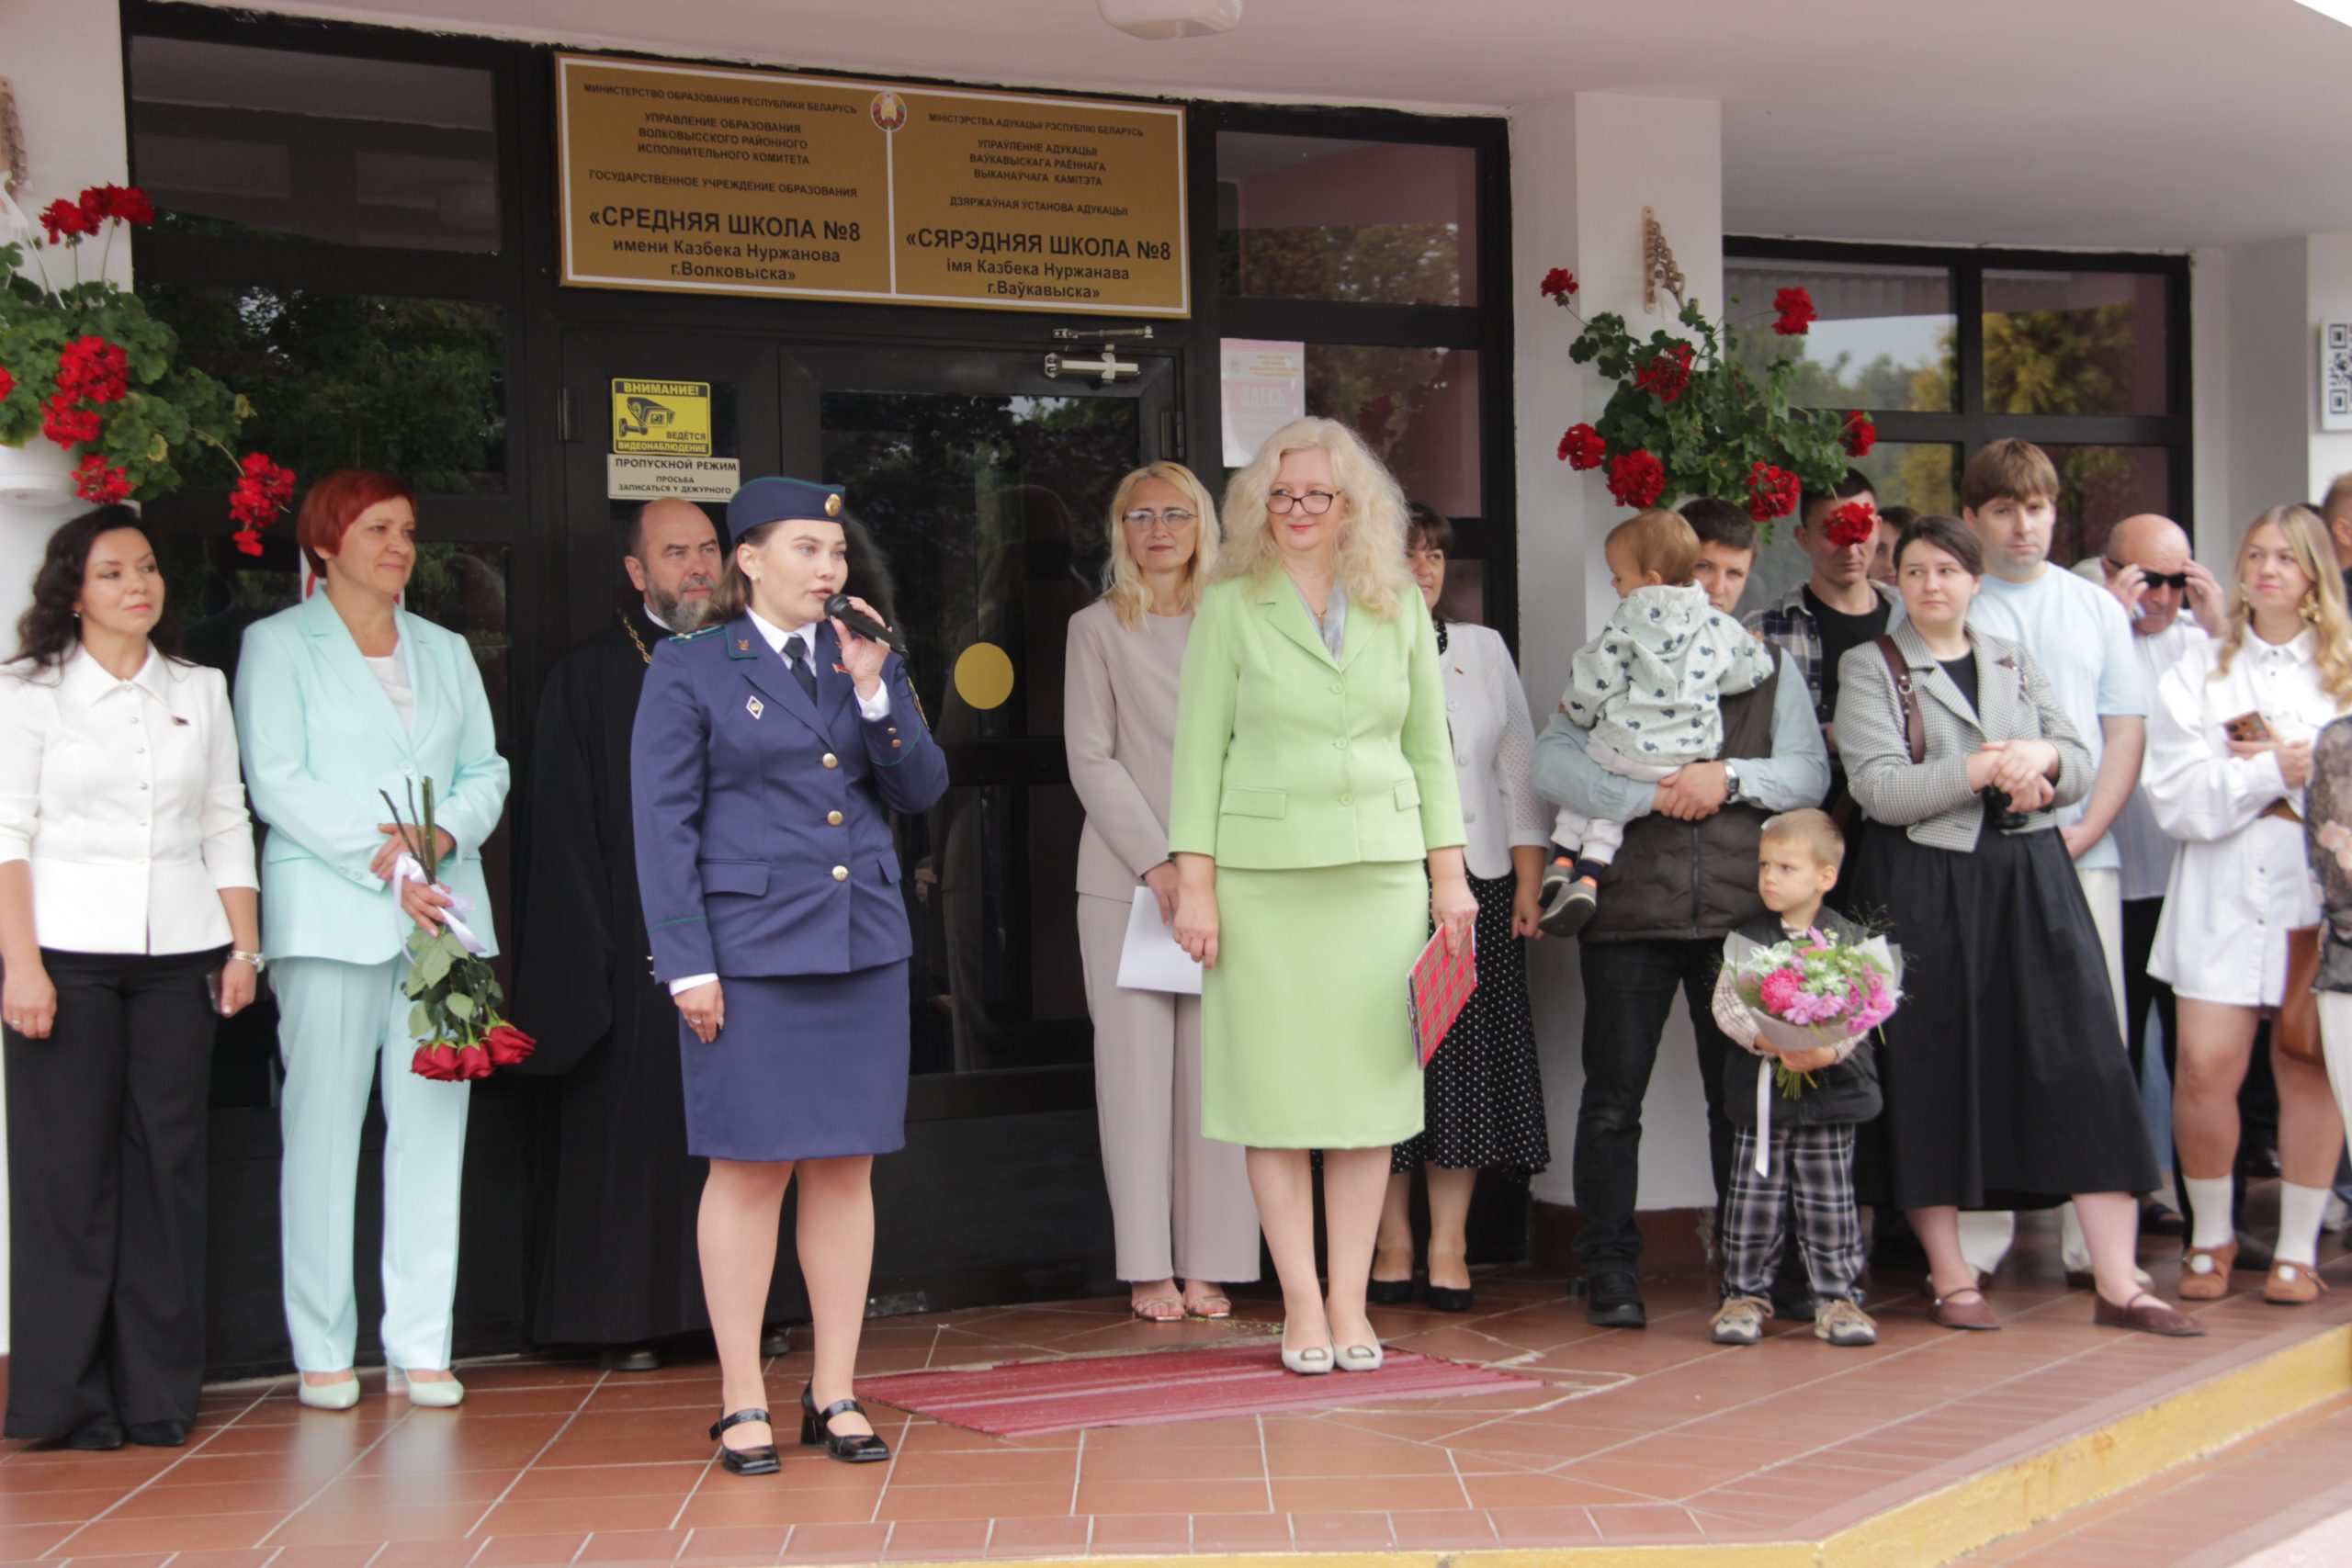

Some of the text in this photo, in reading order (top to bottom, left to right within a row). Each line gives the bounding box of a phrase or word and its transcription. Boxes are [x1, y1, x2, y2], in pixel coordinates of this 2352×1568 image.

[584, 84, 857, 114] МИНИСТЕРСТВО ОБРАЗОВАНИЯ РЕСПУБЛИКИ БЕЛАРУСЬ
[644, 112, 801, 133] УПРАВЛЕНИЕ ОБРАЗОВАНИЯ
[929, 113, 1144, 137] МІНІСТЭРСТВА АДУКАЦЫІ РЭСПУБЛІКІ БЕЛАРУСЬ
[639, 127, 808, 149] ВОЛКОВЫССКОГО РАЙОННОГО
[638, 143, 809, 164] ИСПОЛНИТЕЛЬНОГО КОМИТЕТА
[1046, 144, 1098, 156] АДУКАЦЫІ
[1054, 159, 1106, 172] РАЁННАГА
[589, 169, 857, 197] ГОСУДАРСТВЕННОЕ УЧРЕЖДЕНИЕ ОБРАЗОВАНИЯ
[1054, 175, 1102, 186] КАМІТЭТА
[1076, 204, 1128, 217] АДУКАЦЫІ
[589, 205, 861, 242] «СРЕДНЯЯ ШКОЛА №8
[613, 239, 841, 263] имени Казбека Нуржанова
[906, 228, 1171, 261] «СЯРЭДНЯЯ ШКОЛА №8
[671, 261, 796, 281] г.Волковыска»
[946, 257, 1130, 281] імя Казбека Нуржанава
[987, 280, 1101, 299] г.Ваўкавыска»
[623, 381, 700, 396] ВНИМАНИЕ!
[1240, 386, 1285, 408] ЗДЕСЬ
[666, 430, 707, 442] ВЕДЁТСЯ
[617, 441, 707, 453] ВИДЕОНАБЛЮДЕНИЕ
[616, 458, 737, 471] ПРОПУСКНОЙ РЕЖИМ
[618, 483, 671, 492] ЗАПИСАТЬСЯ
[681, 486, 732, 495] ДЕЖУРНОГО
[656, 475, 695, 484] ПРОСЬБА
